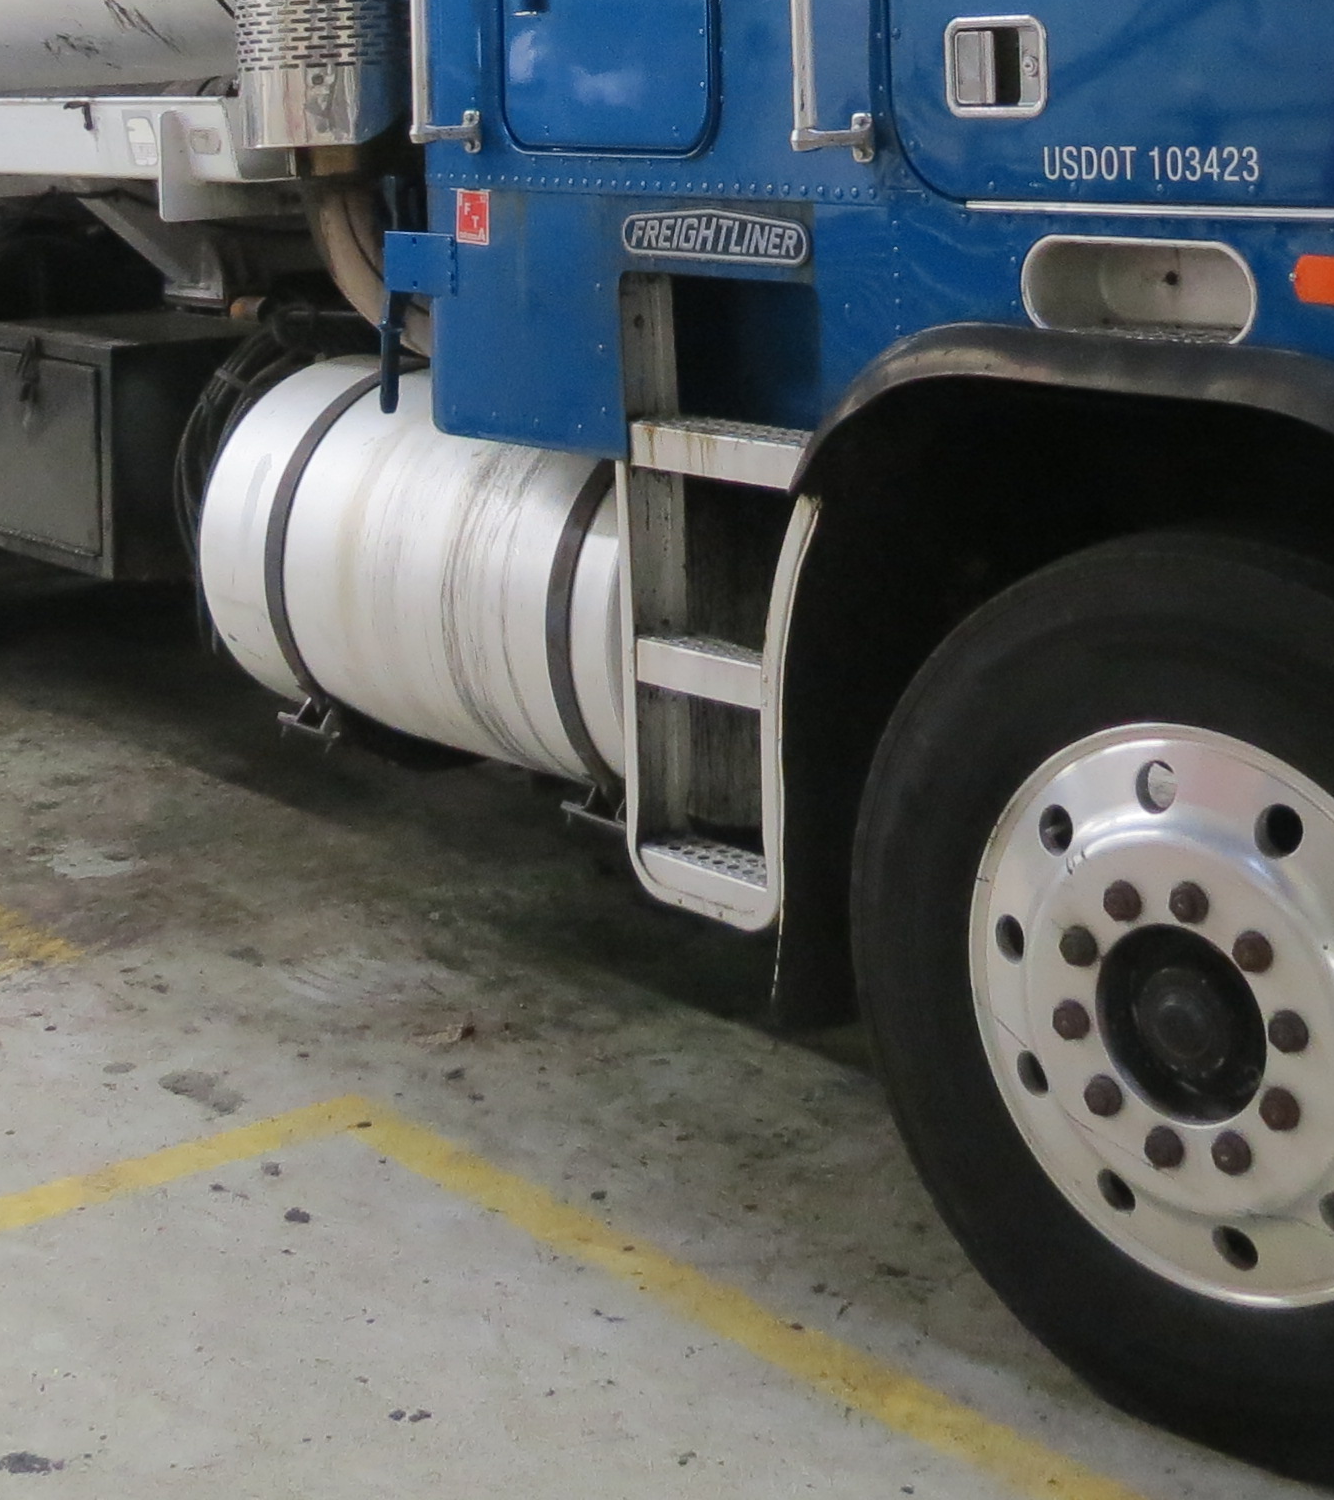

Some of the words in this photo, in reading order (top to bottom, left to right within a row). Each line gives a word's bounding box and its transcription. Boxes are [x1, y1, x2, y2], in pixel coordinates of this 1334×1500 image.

[1043, 146, 1137, 180] USDOT
[1148, 146, 1260, 182] 103423
[630, 217, 798, 257] FREIGHTLINER
